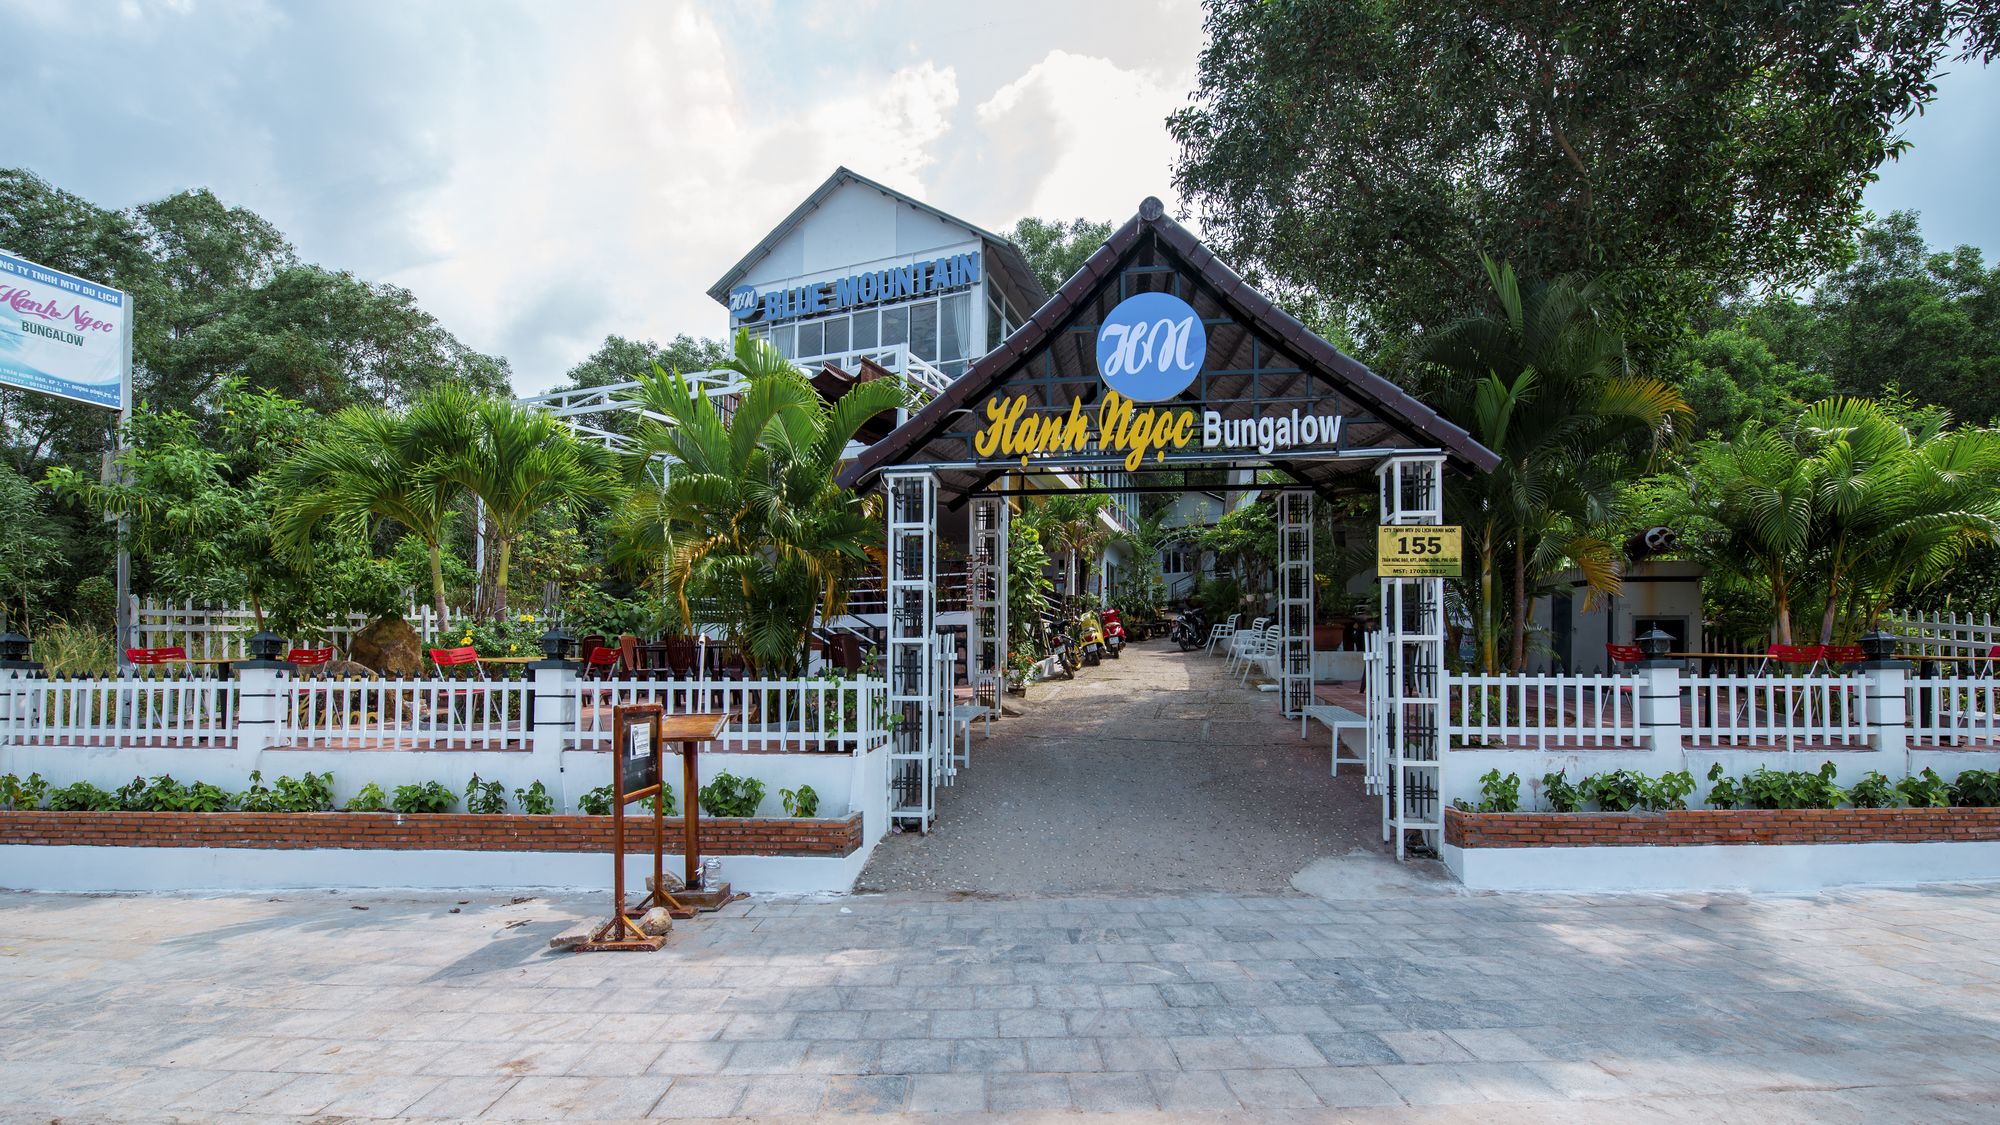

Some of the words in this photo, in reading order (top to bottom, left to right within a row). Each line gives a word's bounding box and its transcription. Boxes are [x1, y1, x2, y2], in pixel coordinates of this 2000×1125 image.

[17, 265, 29, 276] TY
[31, 269, 58, 284] TNHH
[60, 279, 80, 292] MTV
[82, 286, 96, 297] DU
[765, 281, 826, 321] BLUE
[836, 251, 980, 308] MOUNTAIN
[22, 321, 84, 347] BUNGALOW
[974, 394, 1091, 467] Hạnh
[1098, 390, 1195, 472] Ngọc
[1203, 408, 1342, 455] Bungalow
[1398, 537, 1442, 554] 155
